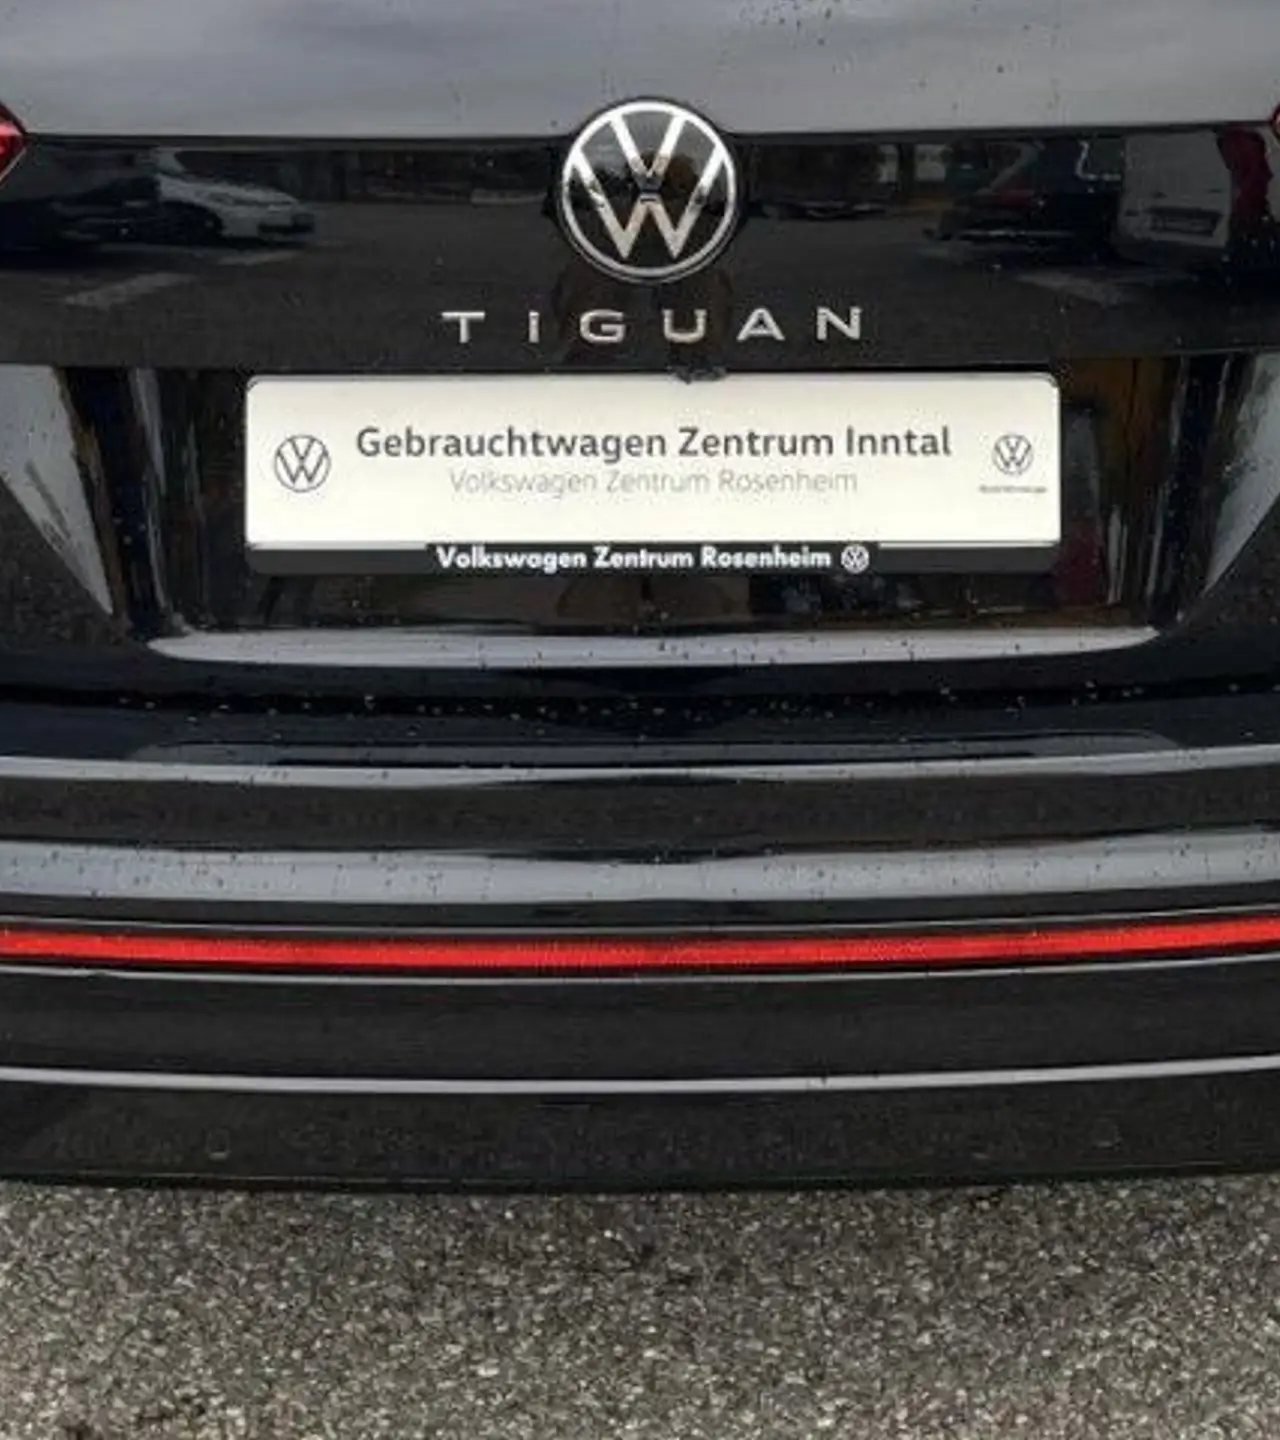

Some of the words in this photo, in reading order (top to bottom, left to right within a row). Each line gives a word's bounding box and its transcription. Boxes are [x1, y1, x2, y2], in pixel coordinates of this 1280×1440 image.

[439, 305, 863, 345] TIGUAN
[355, 425, 668, 464] Gebrauchtwagen
[677, 426, 835, 459] Zentrum
[845, 425, 952, 457] Inntal
[450, 469, 598, 498] Volkswagen
[605, 469, 711, 494] Zentrum
[717, 468, 859, 494] Rosenheim
[435, 544, 587, 573] Volkswagen
[593, 546, 694, 568] Zentrum
[700, 544, 832, 568] Rosenheim
